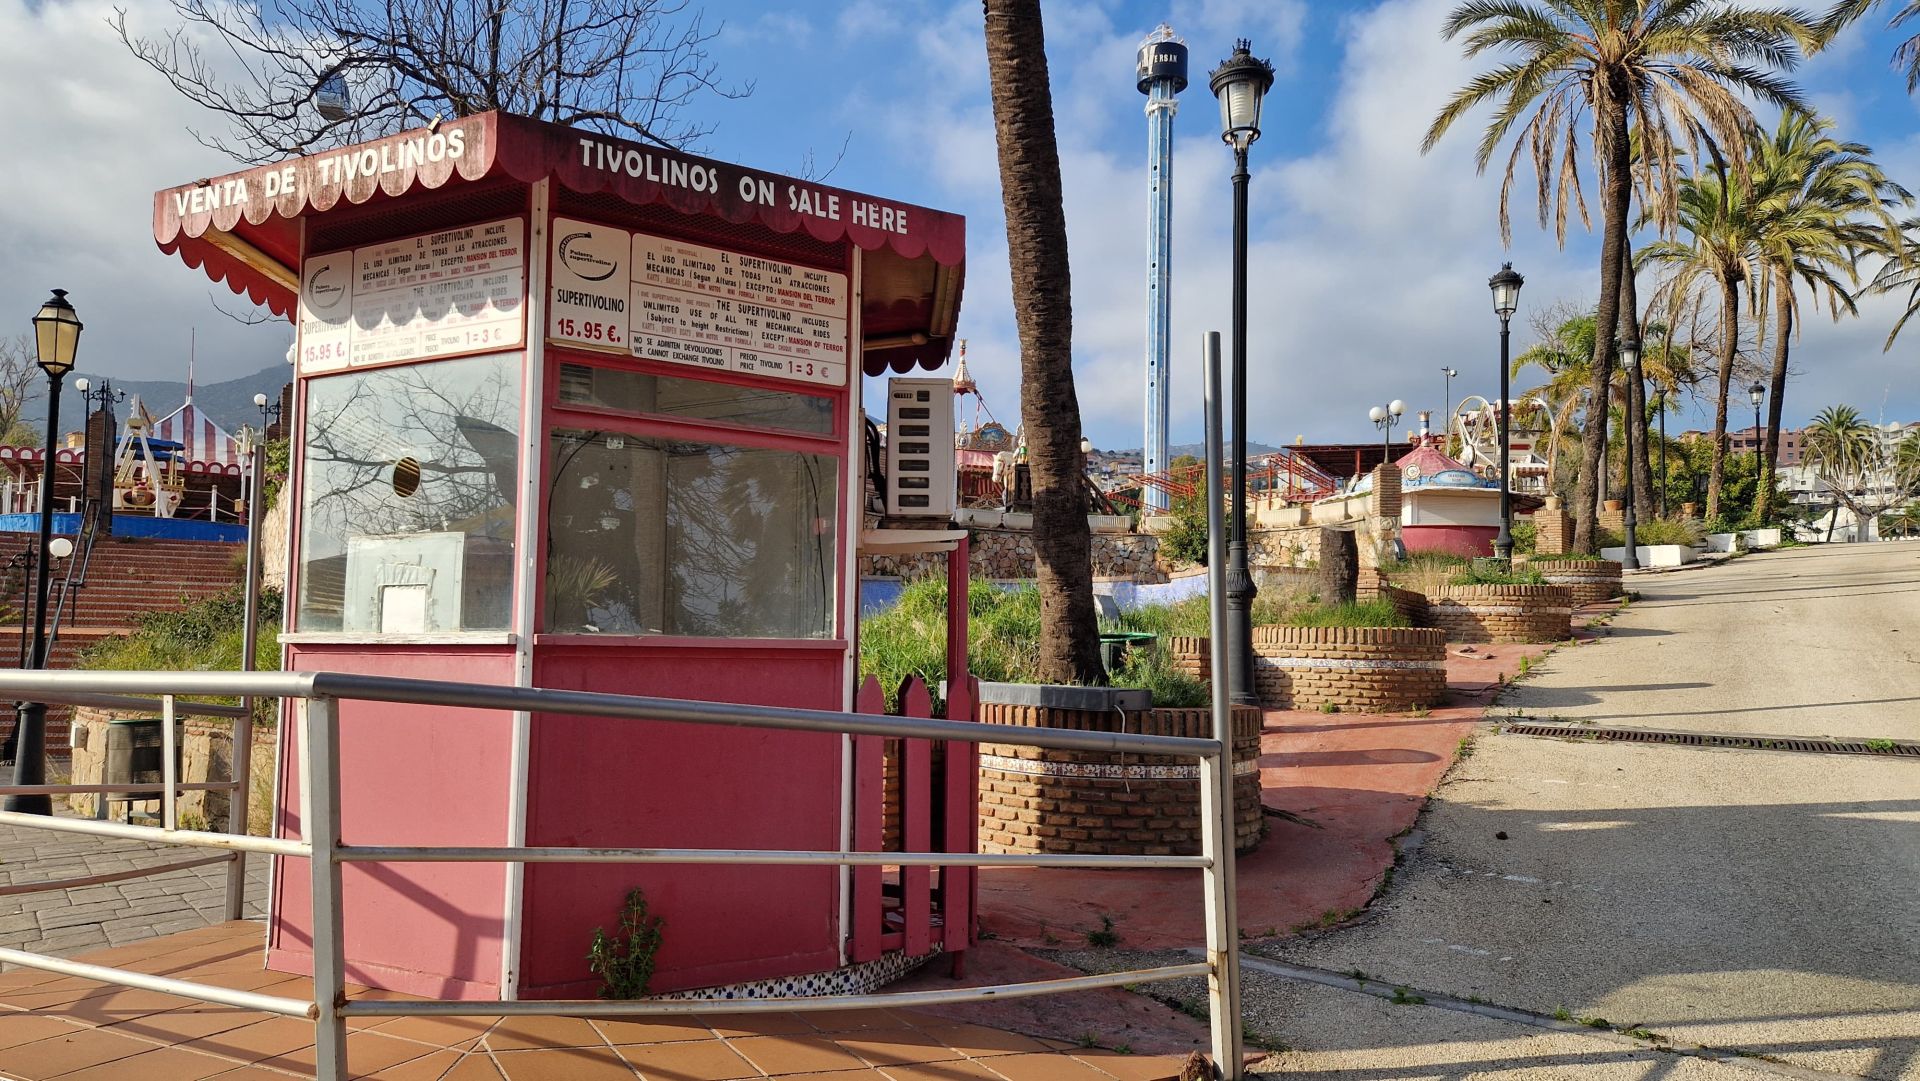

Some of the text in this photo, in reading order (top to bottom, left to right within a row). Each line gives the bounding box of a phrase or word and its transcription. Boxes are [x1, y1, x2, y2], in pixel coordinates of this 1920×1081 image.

[176, 128, 465, 216] VENTA DE TIVOLINOS
[579, 138, 908, 235] TIVOLINOS ON SALE HERE
[416, 225, 506, 248] EL SUPERTIVOLINO INCLUYE
[363, 269, 390, 281] MECANICAS
[488, 250, 498, 259] DEL
[499, 248, 518, 257] TERROR
[364, 262, 369, 270] EL
[419, 251, 426, 260] DE
[432, 248, 448, 258] TODAS
[455, 244, 465, 252] LAS
[472, 236, 508, 250] ATRACCIONES
[721, 252, 828, 282] EL SUPERTIVOLINO INCLUYE
[646, 263, 685, 278] MECANICAS
[777, 288, 802, 300] MANSION
[803, 291, 814, 302] DEL
[814, 294, 836, 306] TERROR
[647, 252, 830, 294] EL USO ILIMITADO DE TODAS LAS ATRACCIONES
[557, 289, 624, 313] SUPERTIVOLINO
[716, 300, 830, 328] THE SUPERTIVOLINO INCLUDES
[558, 318, 602, 340] 15.95
[643, 300, 831, 338] UNLIMITED USE OF ALL THE MECHANICAL RIDES
[634, 336, 642, 344] NO
[646, 338, 653, 346] SE
[684, 343, 723, 356] DEVOLUCIONES
[680, 318, 686, 326] to
[692, 320, 709, 331] height
[788, 336, 813, 347] MANSION
[814, 340, 822, 348] OF
[822, 342, 844, 353] TERROR
[305, 343, 331, 362] 15.95
[634, 346, 724, 366] WE CANNOT EXCHANGE TIVOLINO
[740, 352, 758, 362] PRECIO
[740, 360, 783, 370] PRICE TIVOLINO
[820, 367, 829, 378] €
